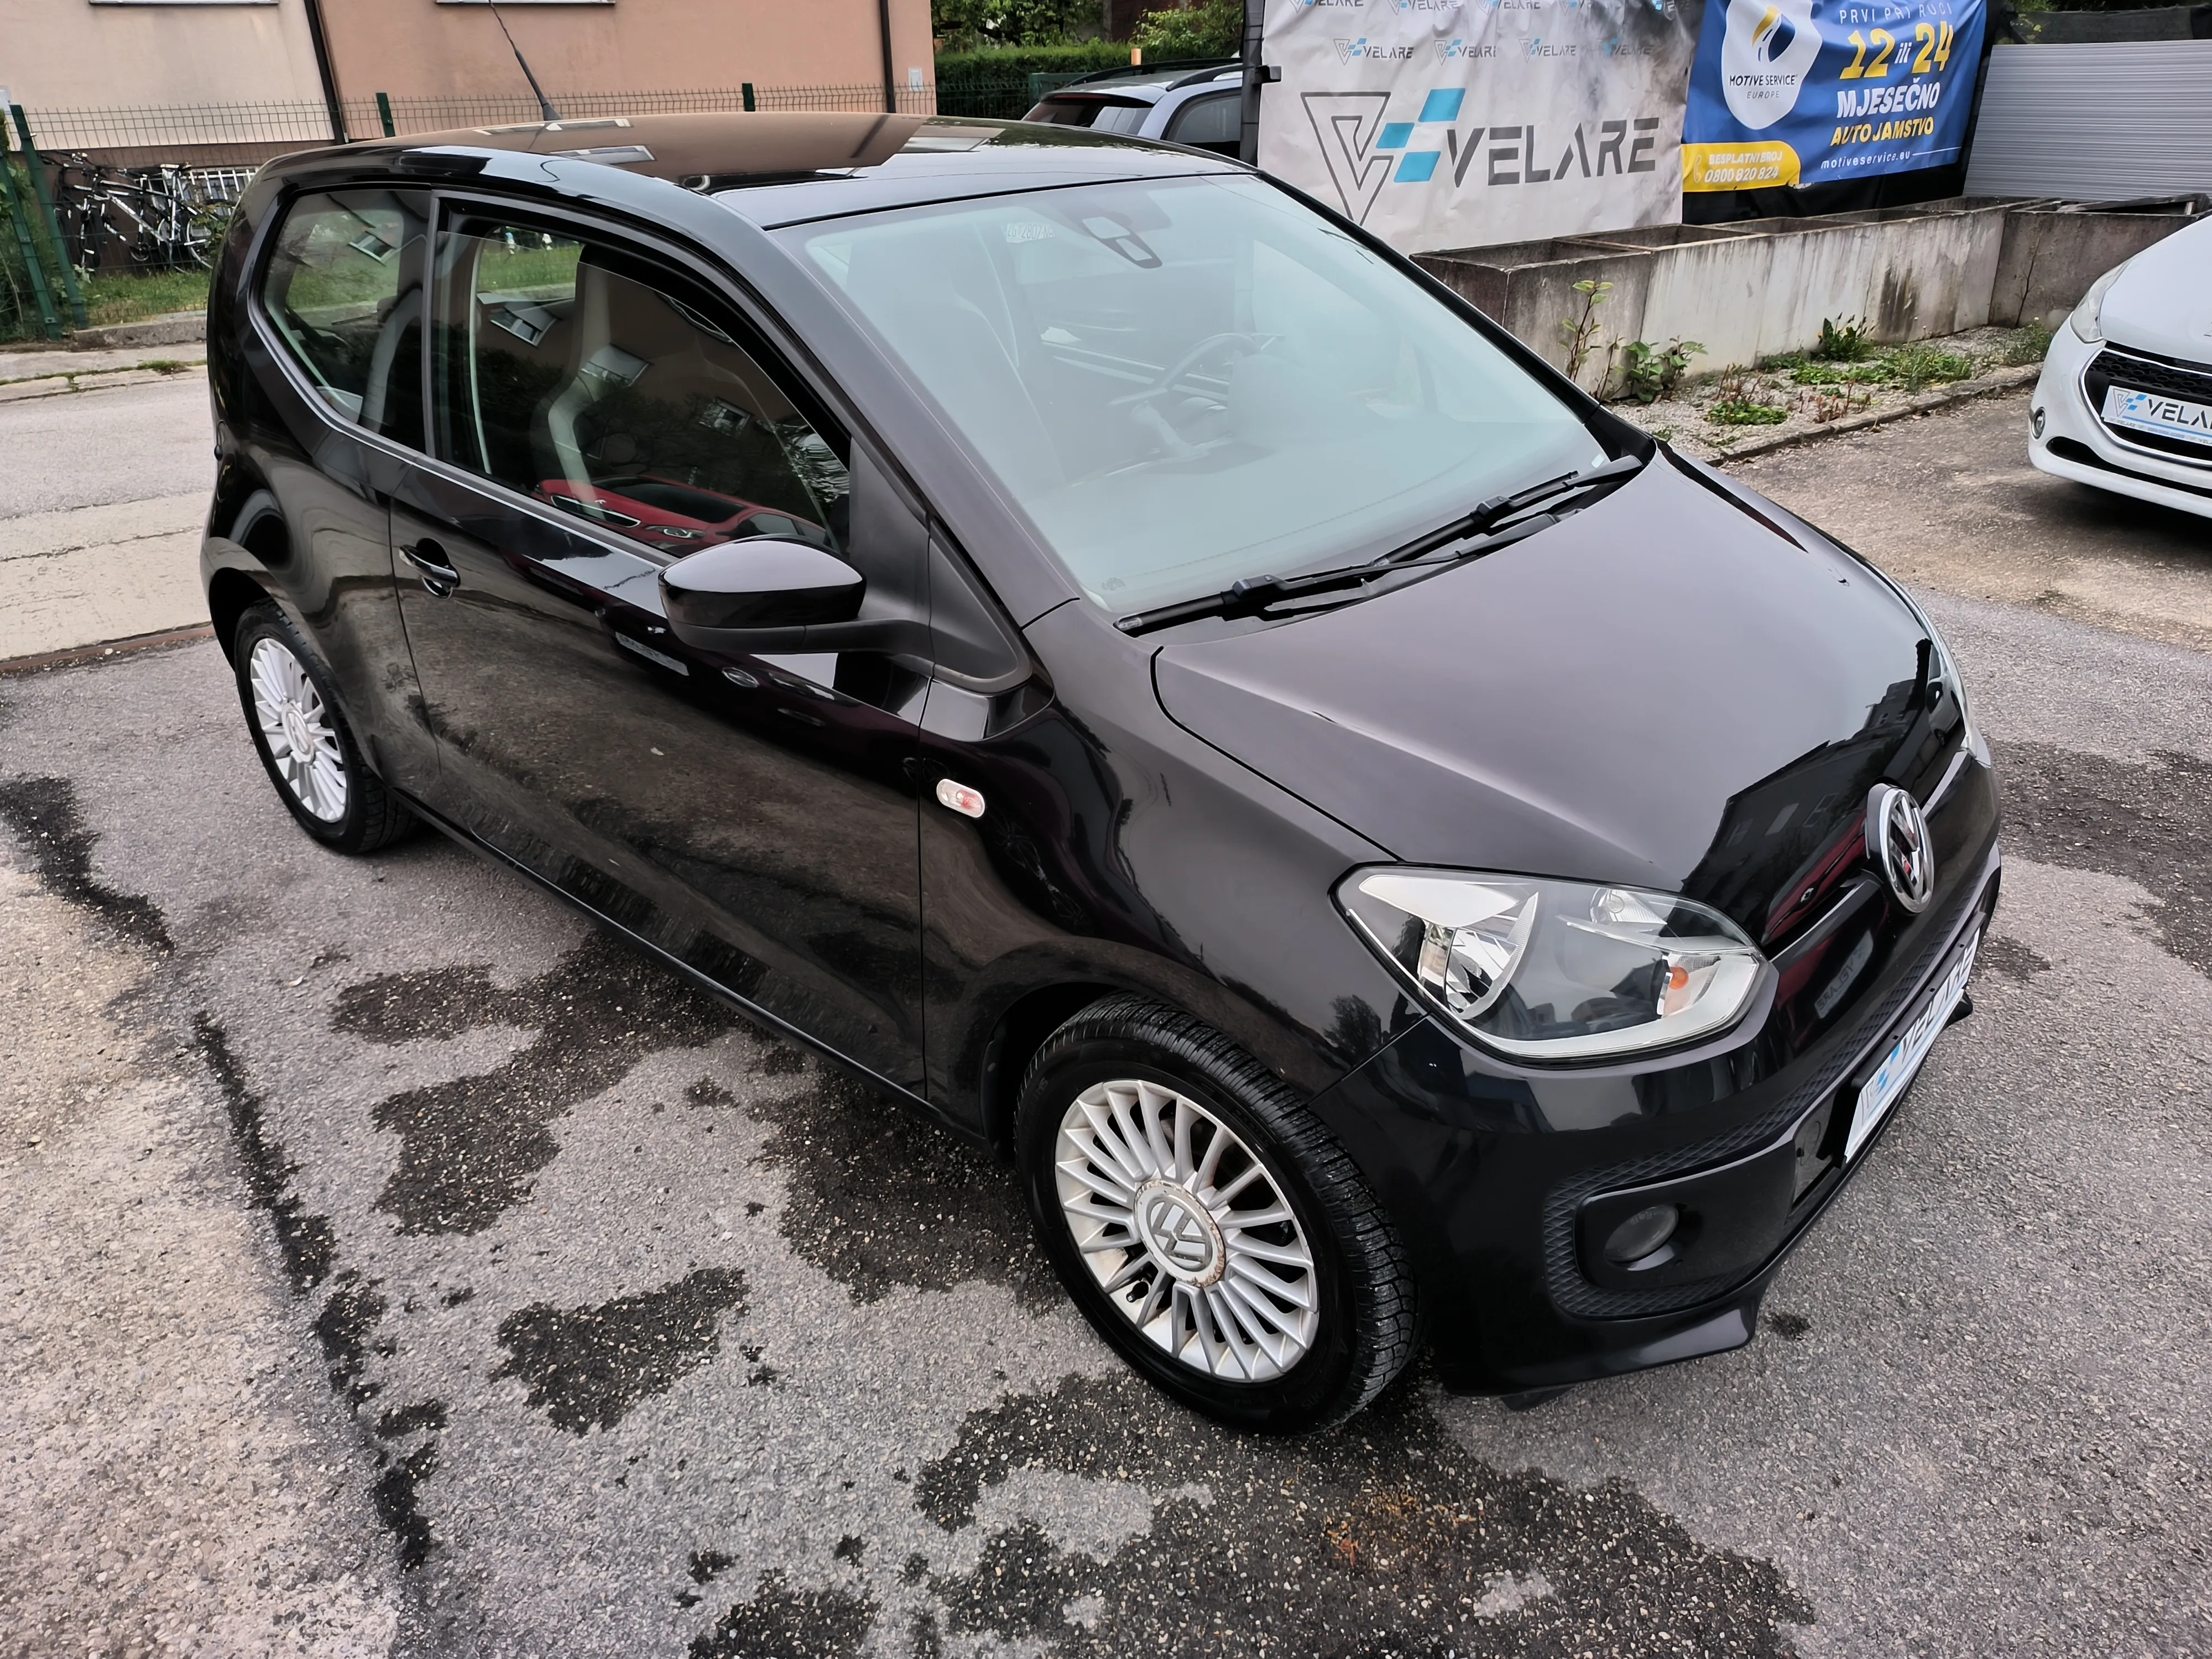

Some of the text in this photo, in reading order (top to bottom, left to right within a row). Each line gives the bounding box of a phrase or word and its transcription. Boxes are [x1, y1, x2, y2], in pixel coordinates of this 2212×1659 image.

[1839, 8, 1875, 24] PRVI
[1919, 2, 1953, 18] RUCI
[1363, 46, 1415, 59] VELARE
[1536, 45, 1577, 57] VELARE
[1839, 20, 1954, 80] 12 ili 24
[1729, 75, 1796, 86] MOTIVE SERVICE
[1746, 91, 1780, 99] EUROPE
[1837, 77, 1940, 118] MJESEČNO
[1830, 116, 1934, 147] AUTO JAMSTVO
[1447, 117, 1660, 189] VELARE
[1709, 150, 1782, 165] BESPLATNI BROJ
[1820, 150, 1911, 170] motiveservice.eu
[1704, 165, 1780, 183] 0800 820 824
[2148, 398, 2212, 430] VELA
